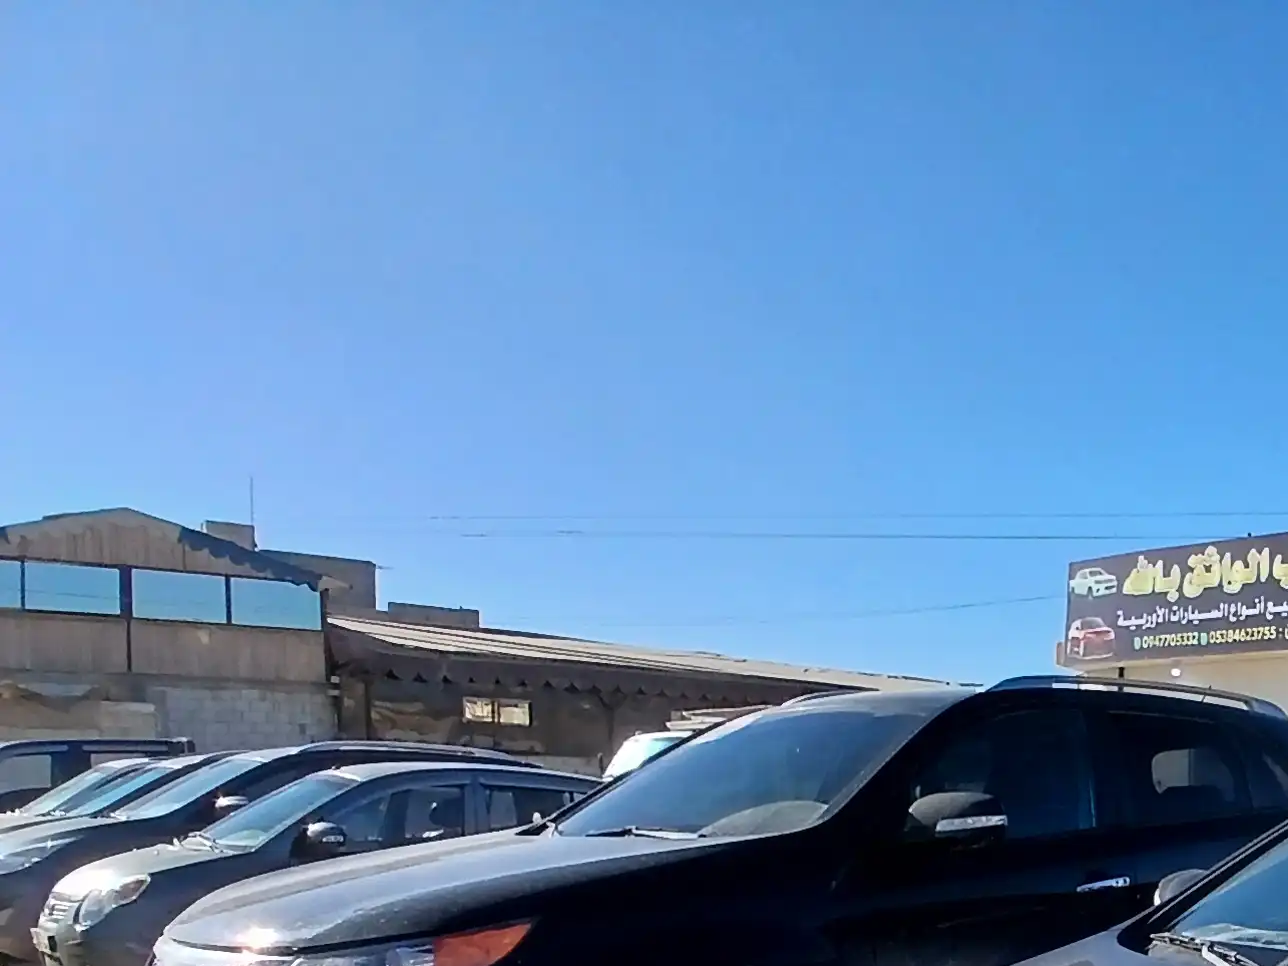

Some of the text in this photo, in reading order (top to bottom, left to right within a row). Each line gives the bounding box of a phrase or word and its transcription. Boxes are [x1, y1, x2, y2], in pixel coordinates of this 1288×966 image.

[1123, 555, 1181, 602] بالله
[1183, 546, 1270, 598] الواثق
[1171, 602, 1229, 626] السيارات
[1229, 595, 1265, 622] أنواع
